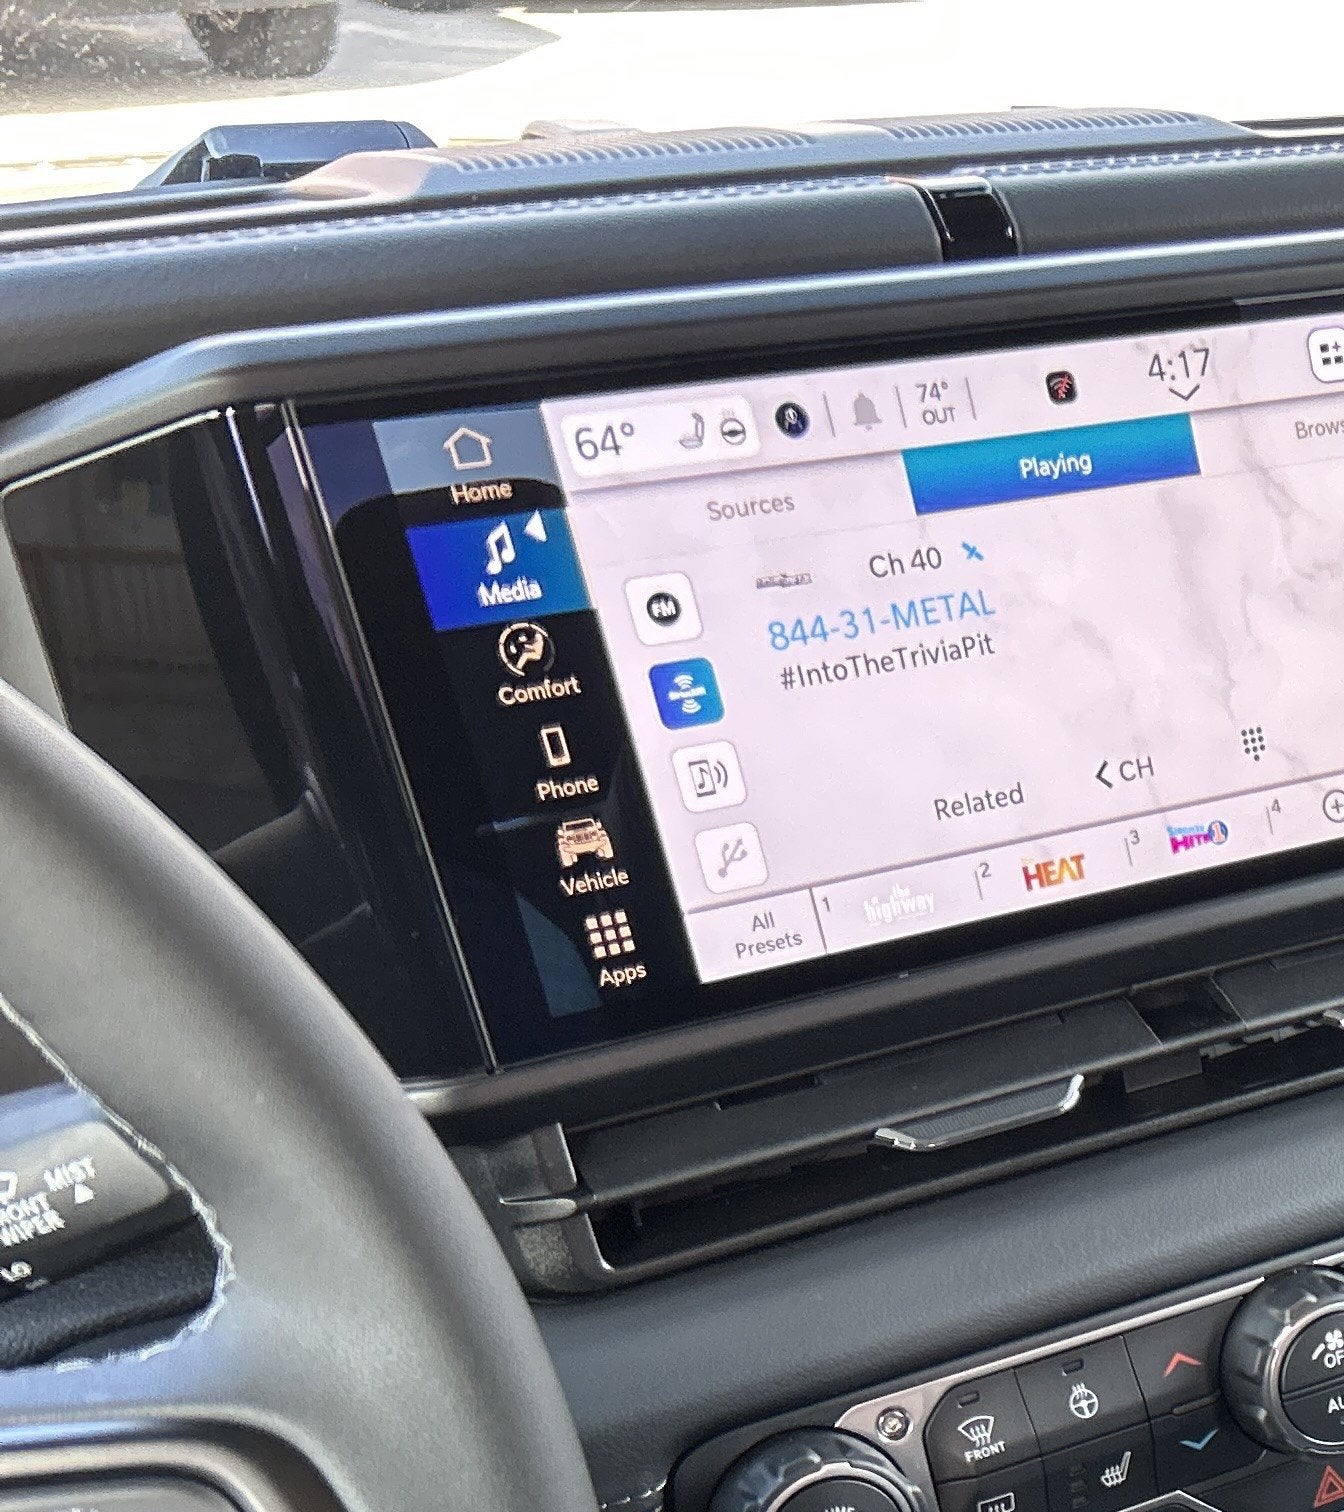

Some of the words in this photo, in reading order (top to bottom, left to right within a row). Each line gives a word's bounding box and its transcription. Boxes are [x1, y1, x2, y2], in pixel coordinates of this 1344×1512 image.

[1146, 347, 1211, 382] 4:17
[921, 405, 957, 427] OUT
[1018, 453, 1092, 482] Playing
[450, 480, 513, 506] Home
[706, 494, 796, 523] Sources
[868, 554, 906, 579] Ch
[911, 547, 943, 571] 40
[478, 576, 542, 607] Media
[652, 598, 676, 617] FM
[767, 588, 996, 652] 844-31-METAL
[780, 632, 995, 691] #IntoTheTriviaPit
[498, 676, 582, 705] Comfort
[1118, 756, 1155, 783] CH
[536, 774, 599, 801] Phone
[933, 782, 1025, 823] Related
[1271, 800, 1281, 814] 4
[1130, 829, 1141, 845] 3
[560, 867, 629, 895] Vehicle
[979, 862, 991, 879] 2
[1022, 853, 1085, 891] HEAT
[822, 896, 832, 912] 1
[864, 892, 935, 924] highway
[751, 911, 775, 933] All
[735, 930, 803, 959] Presets
[599, 962, 647, 987] Apps
[43, 1155, 96, 1193] MIST
[964, 1439, 1007, 1463] FRONT
